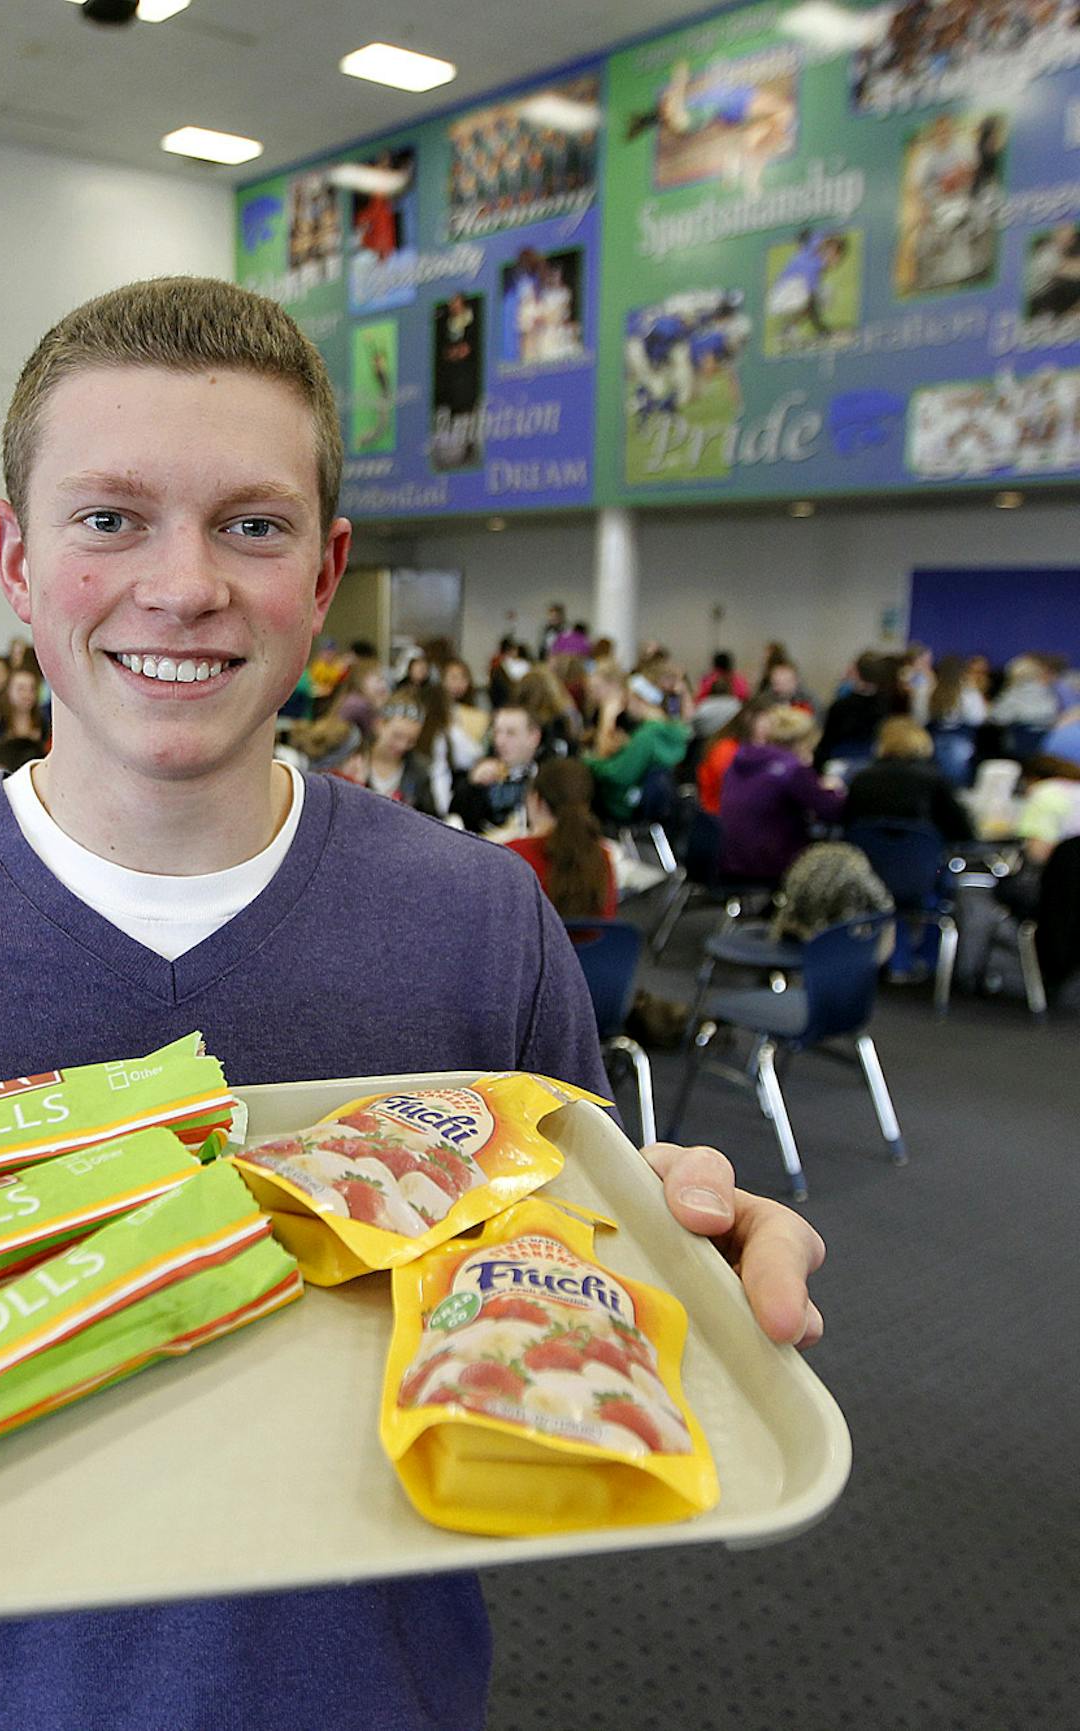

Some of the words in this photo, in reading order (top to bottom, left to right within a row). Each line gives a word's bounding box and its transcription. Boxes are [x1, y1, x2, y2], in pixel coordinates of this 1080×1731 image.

[644, 390, 823, 473] Pride
[129, 1065, 164, 1083] Other
[465, 1260, 623, 1316] Fruchi
